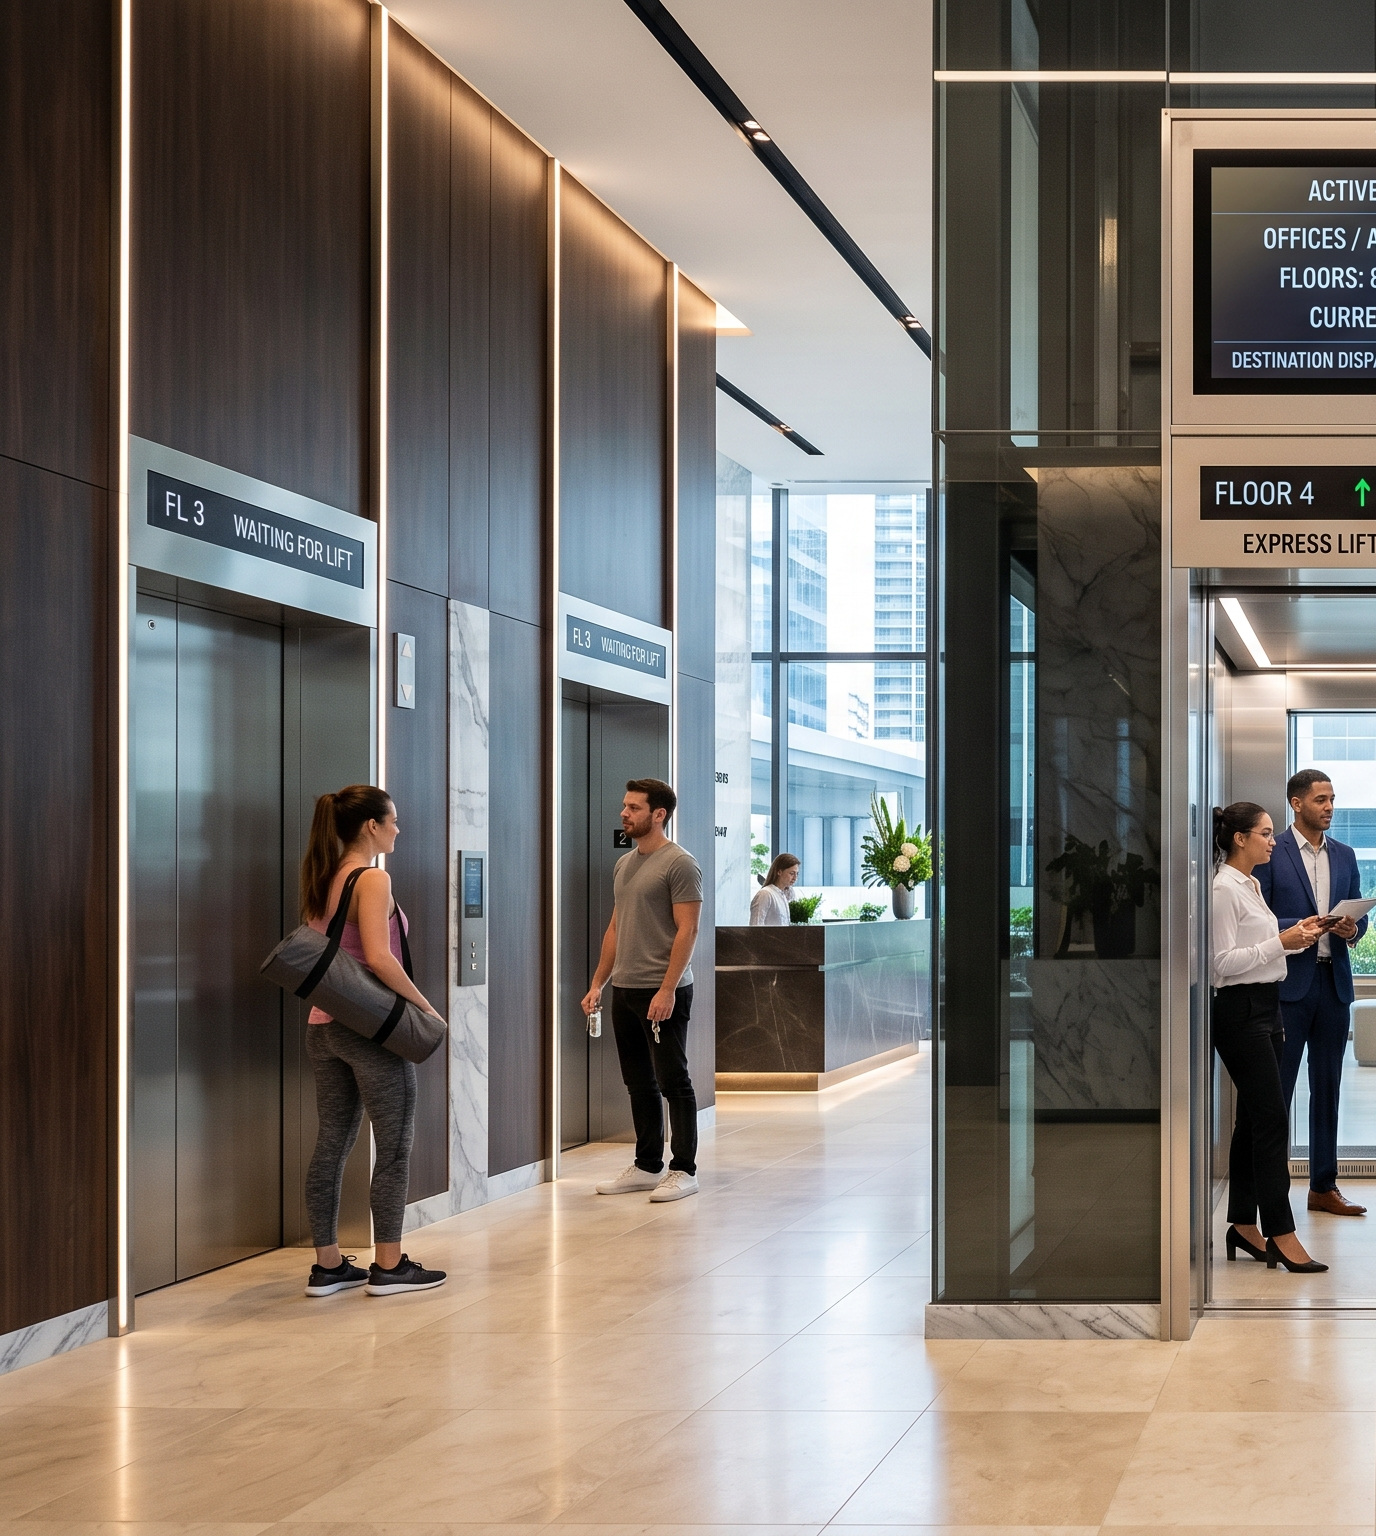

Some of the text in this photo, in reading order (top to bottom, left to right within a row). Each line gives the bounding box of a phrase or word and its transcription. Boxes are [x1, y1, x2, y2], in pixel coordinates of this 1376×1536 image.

[1263, 227, 1347, 250] OFFICES
[1350, 227, 1362, 252] /
[1280, 266, 1364, 289] FLOORS:
[1232, 351, 1334, 369] DESTINATION
[1215, 480, 1292, 506] FLOOR
[1299, 480, 1315, 506] 4
[165, 490, 354, 571] FL 3 WAITING FOR LIFT
[1243, 533, 1332, 554] EXPRESS
[573, 627, 584, 647] FL
[584, 630, 591, 649] 3
[619, 832, 627, 845] 2
